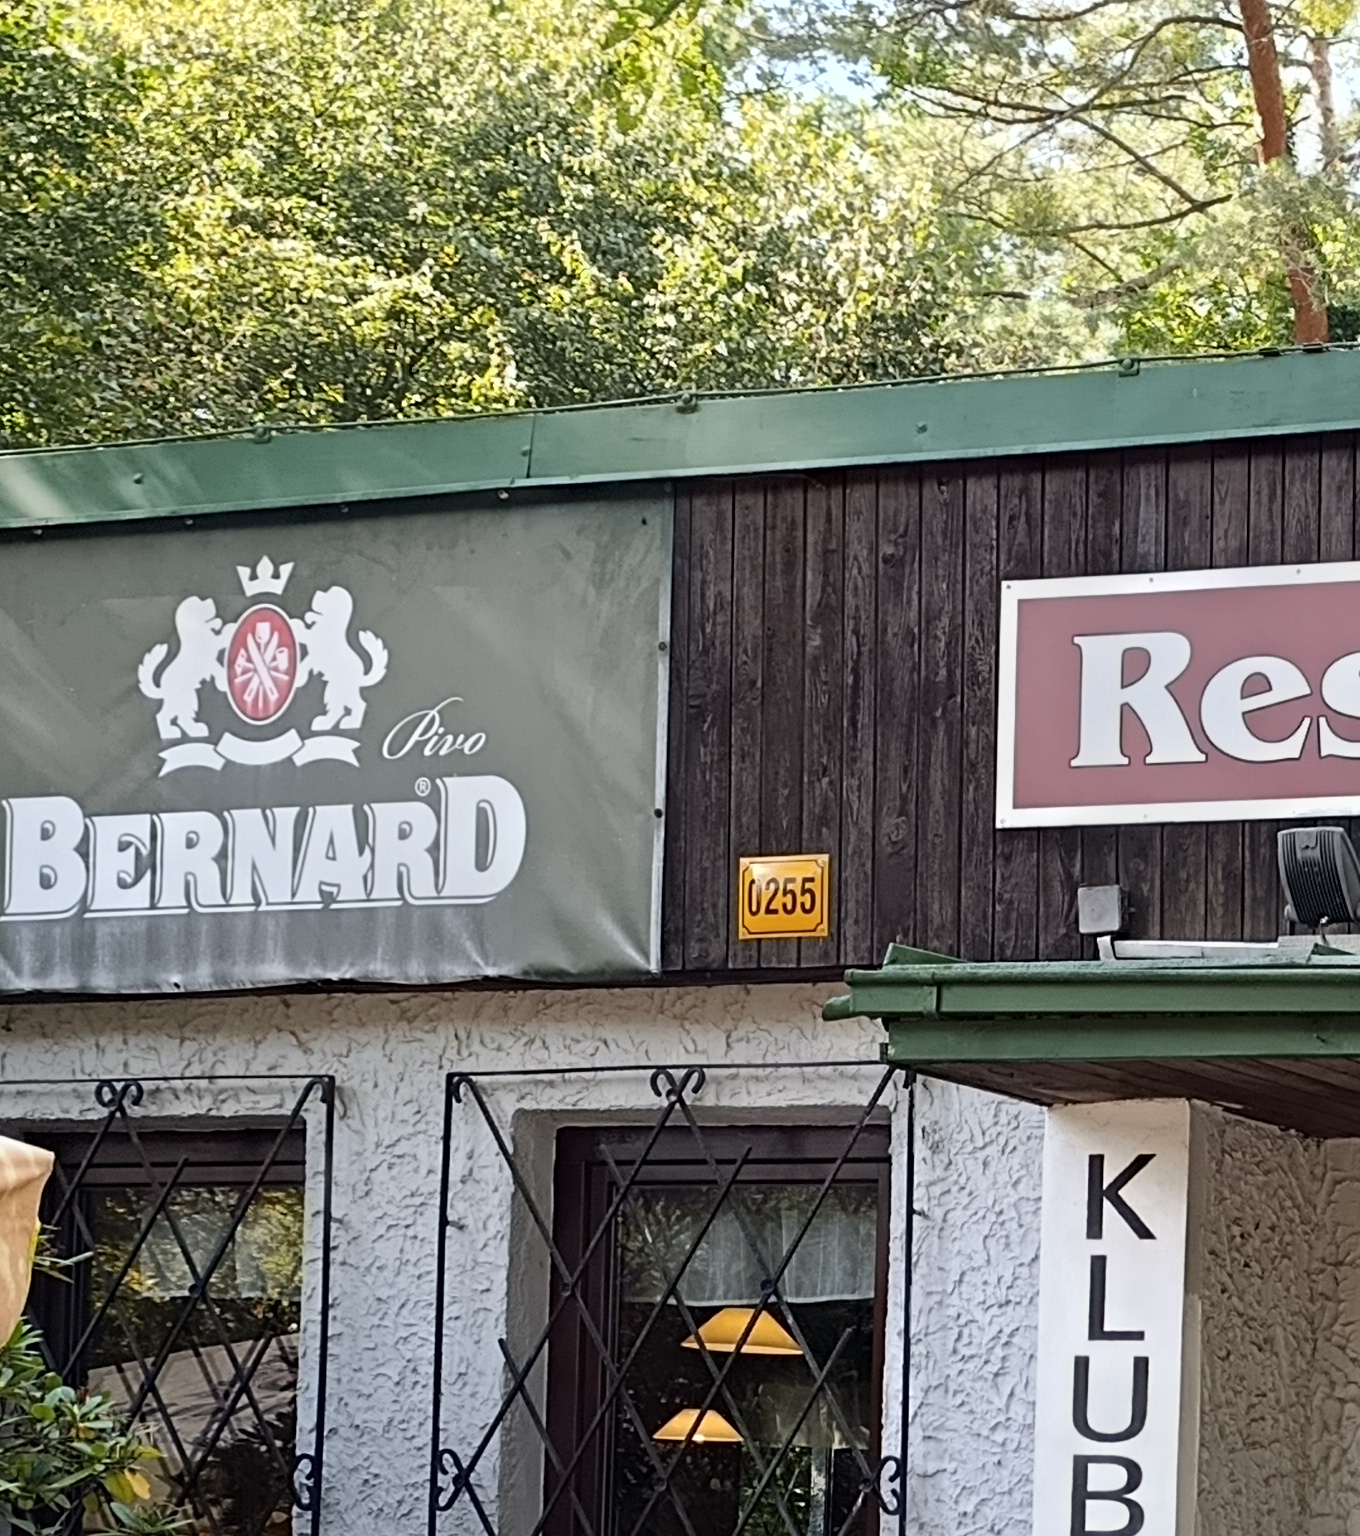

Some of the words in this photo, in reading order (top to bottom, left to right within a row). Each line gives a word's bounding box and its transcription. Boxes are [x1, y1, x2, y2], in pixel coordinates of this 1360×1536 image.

[382, 697, 486, 760] Pivo
[0, 774, 527, 922] BERNARD
[747, 876, 817, 917] 0255
